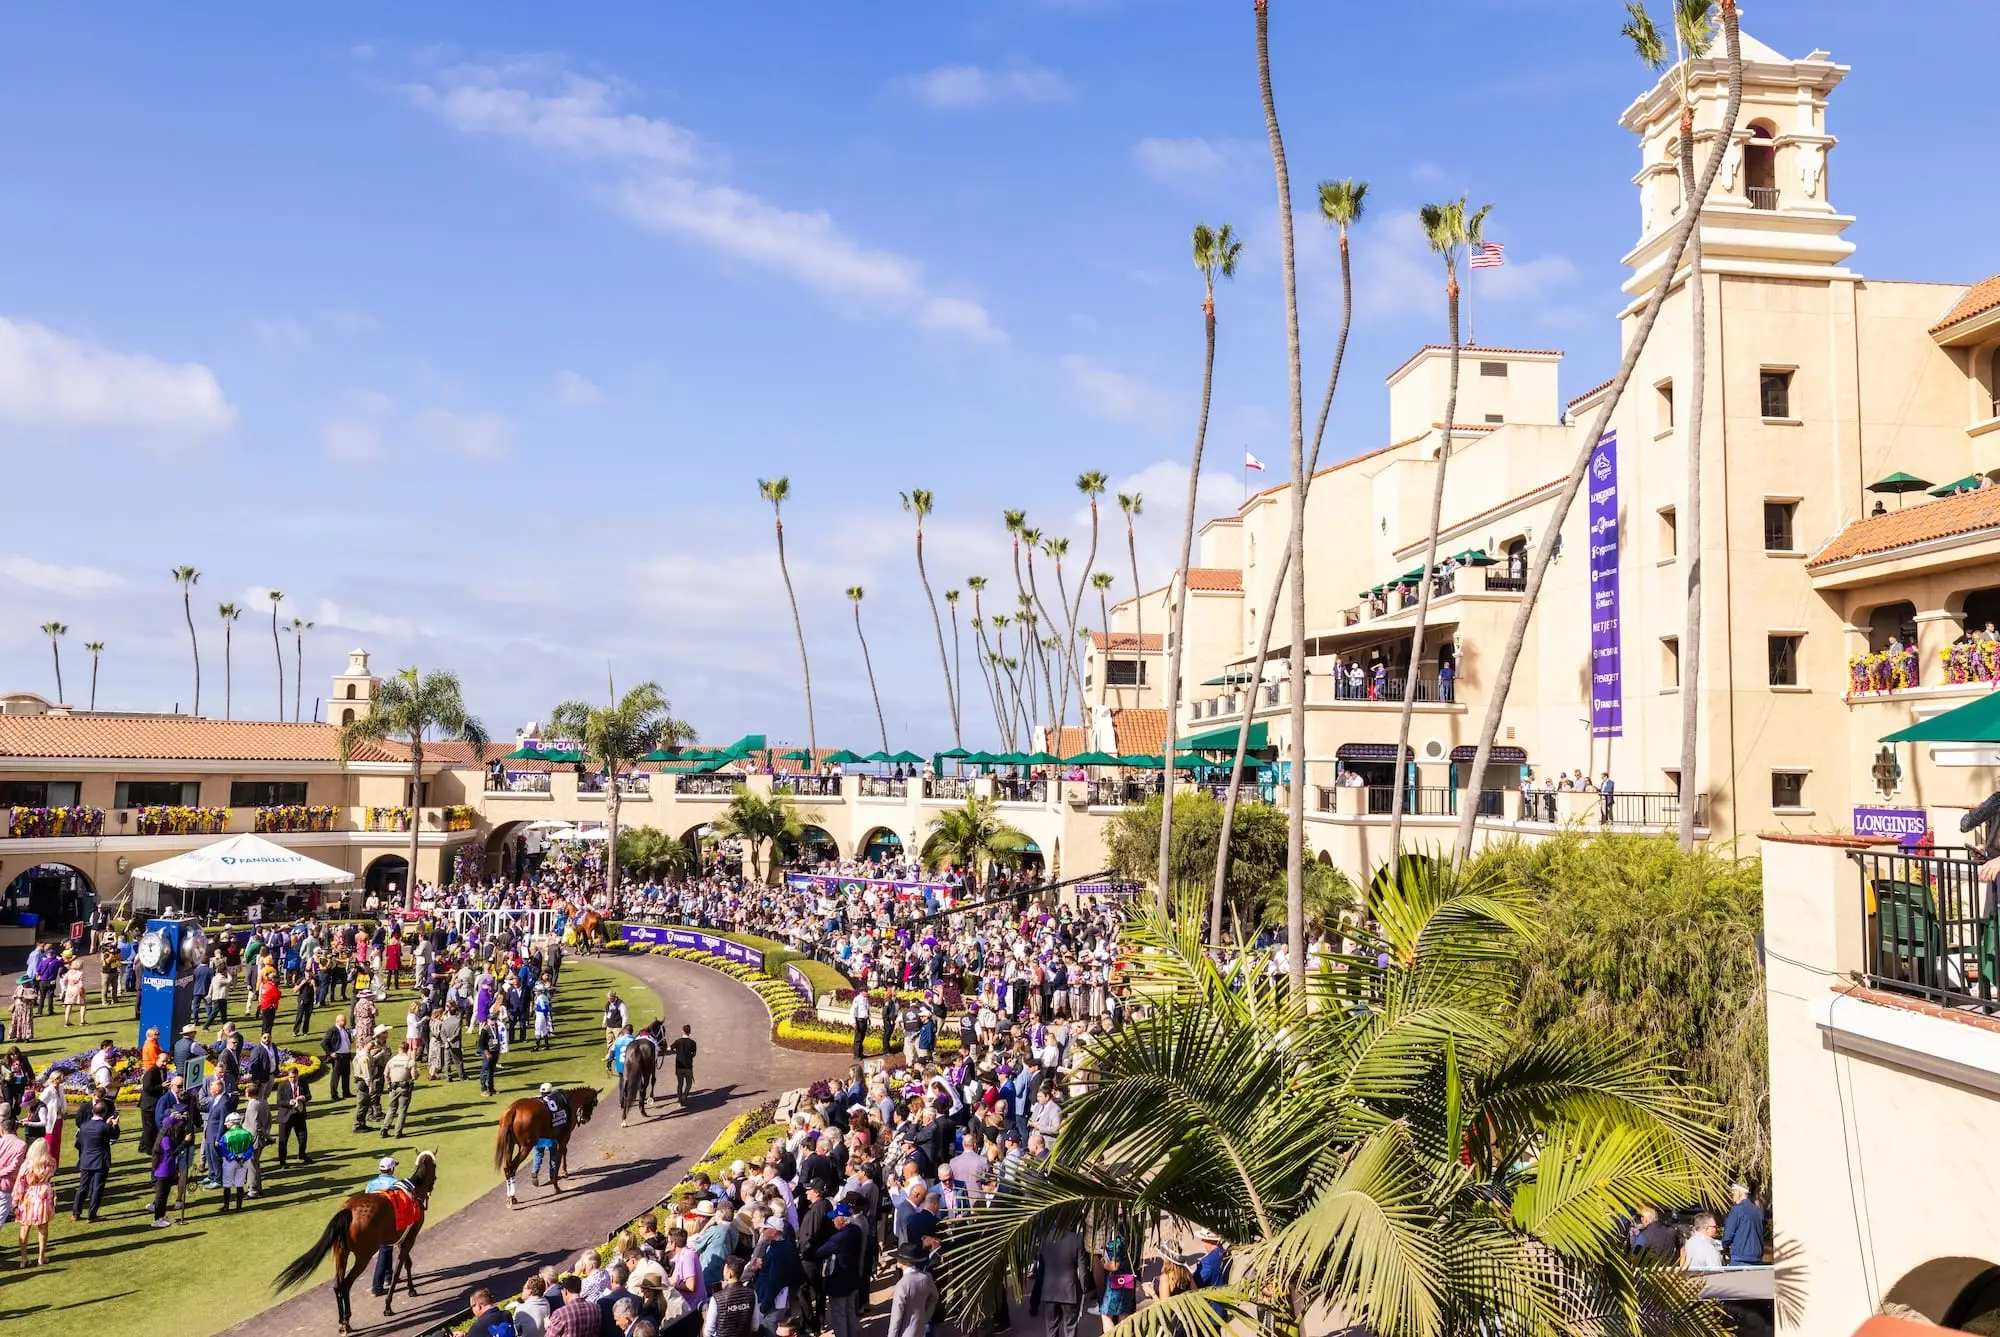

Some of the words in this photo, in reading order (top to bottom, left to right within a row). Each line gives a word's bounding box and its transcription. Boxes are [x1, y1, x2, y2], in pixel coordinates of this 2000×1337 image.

[1856, 815, 1924, 833] LONGINES
[252, 908, 258, 918] 2
[192, 1063, 200, 1084] 9
